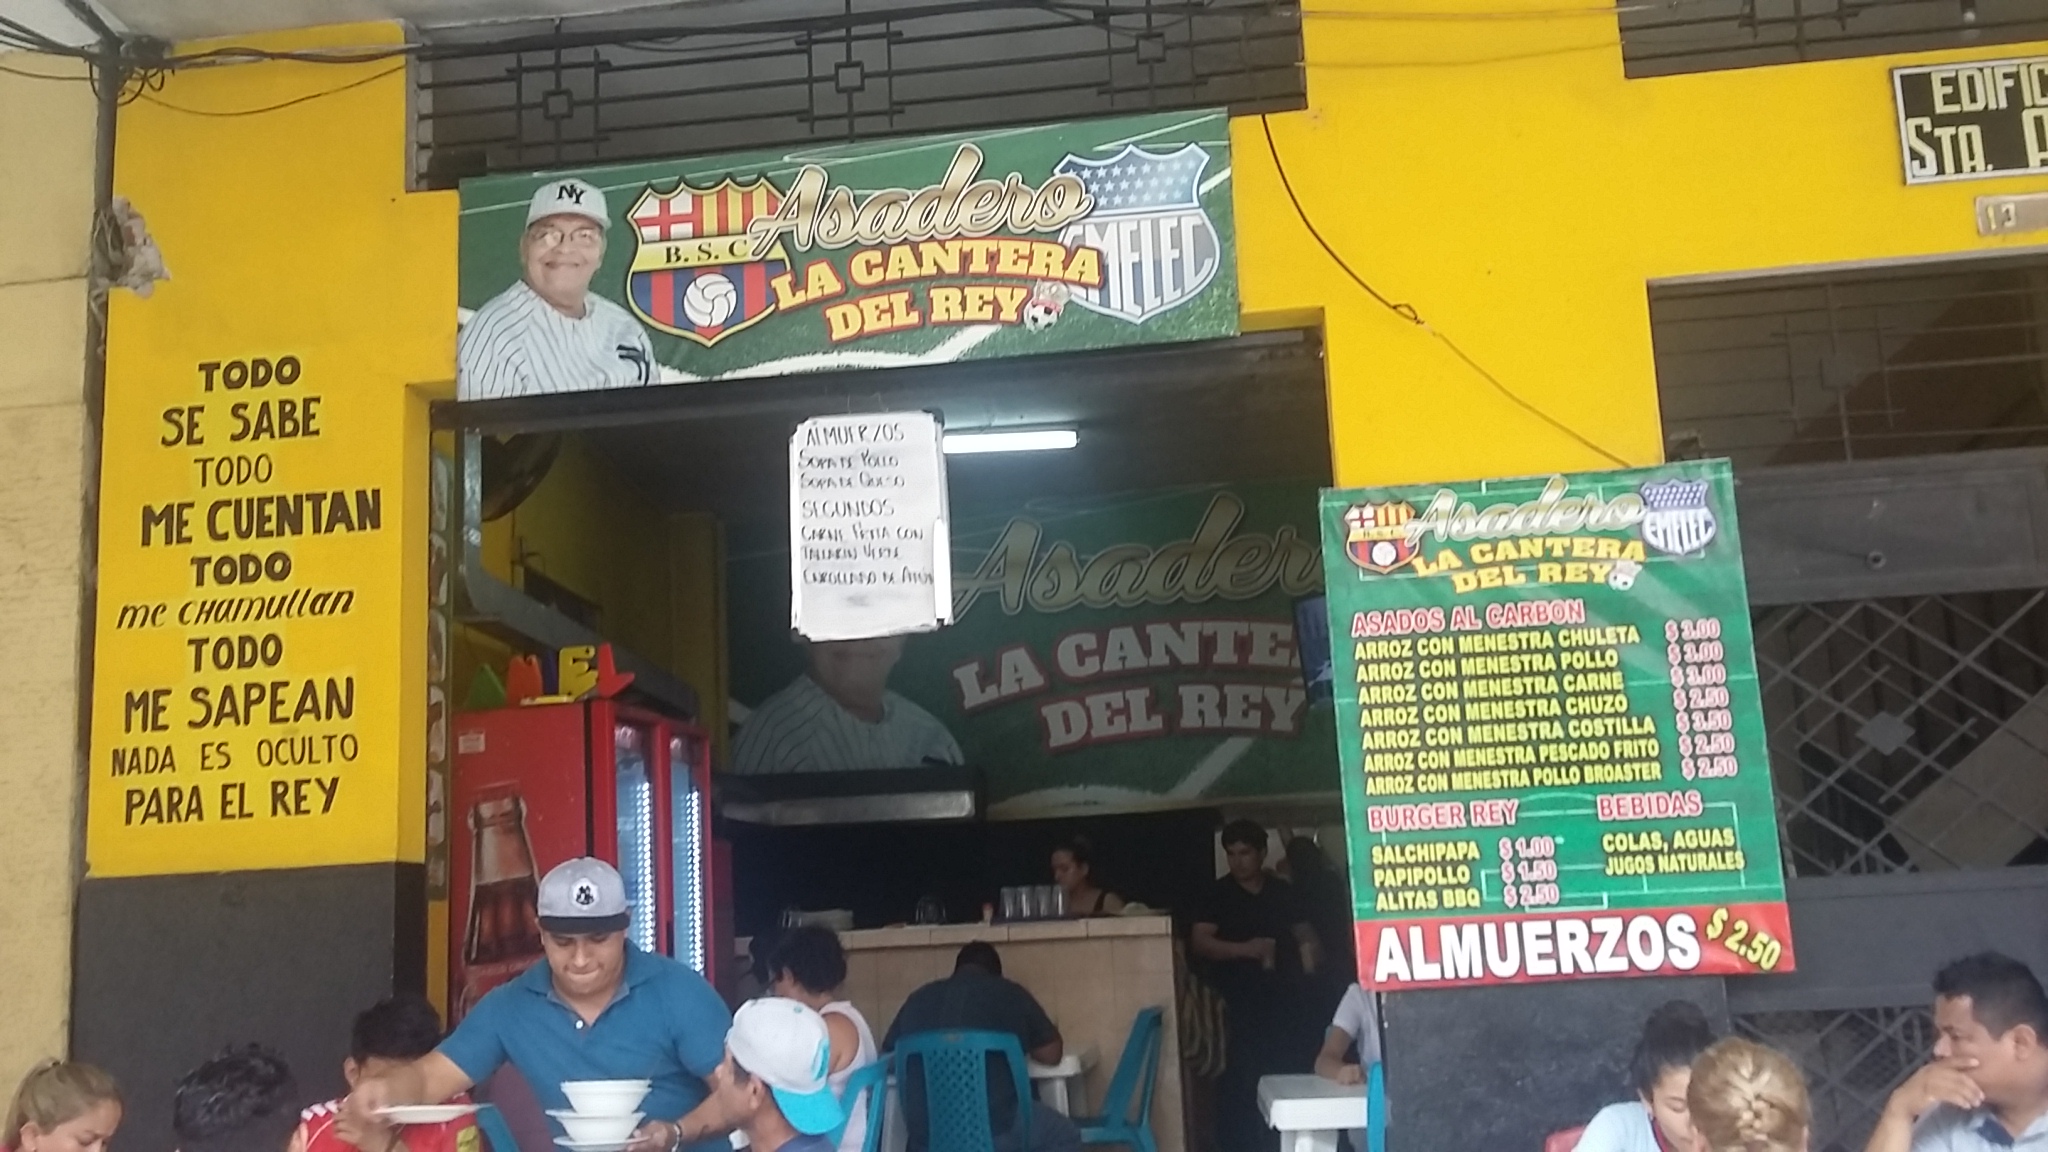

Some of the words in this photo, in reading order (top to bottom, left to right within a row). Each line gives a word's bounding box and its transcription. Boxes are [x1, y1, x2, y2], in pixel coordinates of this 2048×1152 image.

[749, 143, 1096, 261] Asadero
[771, 262, 842, 310] LA
[851, 241, 1101, 285] CANTERA
[826, 291, 919, 340] DEL
[930, 286, 1029, 322] REY
[198, 356, 301, 392] TODO
[161, 406, 204, 447] SE
[229, 396, 321, 443] SABE
[194, 453, 272, 488] TODO
[141, 502, 195, 547] ME
[207, 488, 381, 541] CUENTAN
[1403, 474, 1648, 547] Asadero
[897, 526, 924, 540] CON
[190, 551, 291, 587] TODO
[953, 491, 1325, 625] Asader
[1412, 549, 1463, 577] LA
[1470, 537, 1645, 564] CANTERA
[1452, 565, 1526, 593] DEL
[1538, 562, 1613, 583] REY
[117, 603, 167, 629] me
[1352, 607, 1445, 637] ASADOS
[1450, 605, 1482, 630] AL
[1486, 598, 1585, 628] CARBON
[187, 633, 282, 672] TODO
[1355, 639, 1413, 660] ARROZ
[1417, 636, 1454, 656] CON
[1459, 631, 1554, 653] MENESTRA
[1558, 625, 1640, 648] CHULETA
[953, 647, 1045, 709] LA
[1058, 621, 1300, 678] CANTE
[1356, 661, 1415, 683] ARROZ
[1419, 659, 1456, 678] CON
[1461, 653, 1557, 676] MENESTRA
[1560, 649, 1618, 670] POLLO
[125, 689, 172, 733] ME
[187, 676, 354, 730] SAPEAN
[1359, 684, 1417, 705] ARROZ
[1421, 682, 1459, 700] CON
[1463, 675, 1559, 698] MENESTRA
[1563, 672, 1624, 693] CARNE
[1041, 687, 1162, 747] DEL
[1178, 684, 1306, 731] REY
[1361, 706, 1419, 728] ARROZ
[1423, 704, 1461, 723] CON
[1465, 698, 1562, 721] MENESTRA
[1565, 694, 1628, 715] CHUZO
[1363, 729, 1421, 750] ARROZ
[1425, 726, 1463, 745] CON
[1467, 721, 1564, 744] MENESTRA
[1568, 715, 1656, 738] COSTILLA
[112, 745, 176, 777] NADA
[201, 742, 231, 771] ES
[257, 733, 358, 768] OCULTO
[1364, 752, 1415, 773] ARROZ
[1418, 750, 1450, 770] CON
[1453, 746, 1536, 767] MENESTRA
[1539, 741, 1610, 763] PESCADO
[1614, 738, 1659, 758] FRITO
[1366, 774, 1415, 795] ARROZ
[1417, 773, 1449, 792] CON
[1452, 768, 1530, 790] MENESTRA
[1533, 765, 1580, 786] POLLO
[1584, 762, 1662, 784] BROASTER
[125, 785, 203, 826] PARA
[220, 783, 254, 820] EL
[270, 777, 339, 817] REY
[1368, 802, 1466, 832] BURGER
[1470, 799, 1519, 827] REY
[1597, 790, 1703, 821] BEBIDAS
[1372, 841, 1480, 865] SALCHIPAPA
[1603, 831, 1668, 853] COLAS,
[1673, 828, 1735, 849] AGUAS
[1374, 865, 1470, 888] PAPIPOLLO
[1605, 855, 1655, 876] JUGOS
[1659, 851, 1744, 873] NATURALES
[1376, 890, 1438, 911] ALITAS
[1443, 888, 1480, 908] BBQ
[1375, 913, 1700, 982] ALMUERZOS
